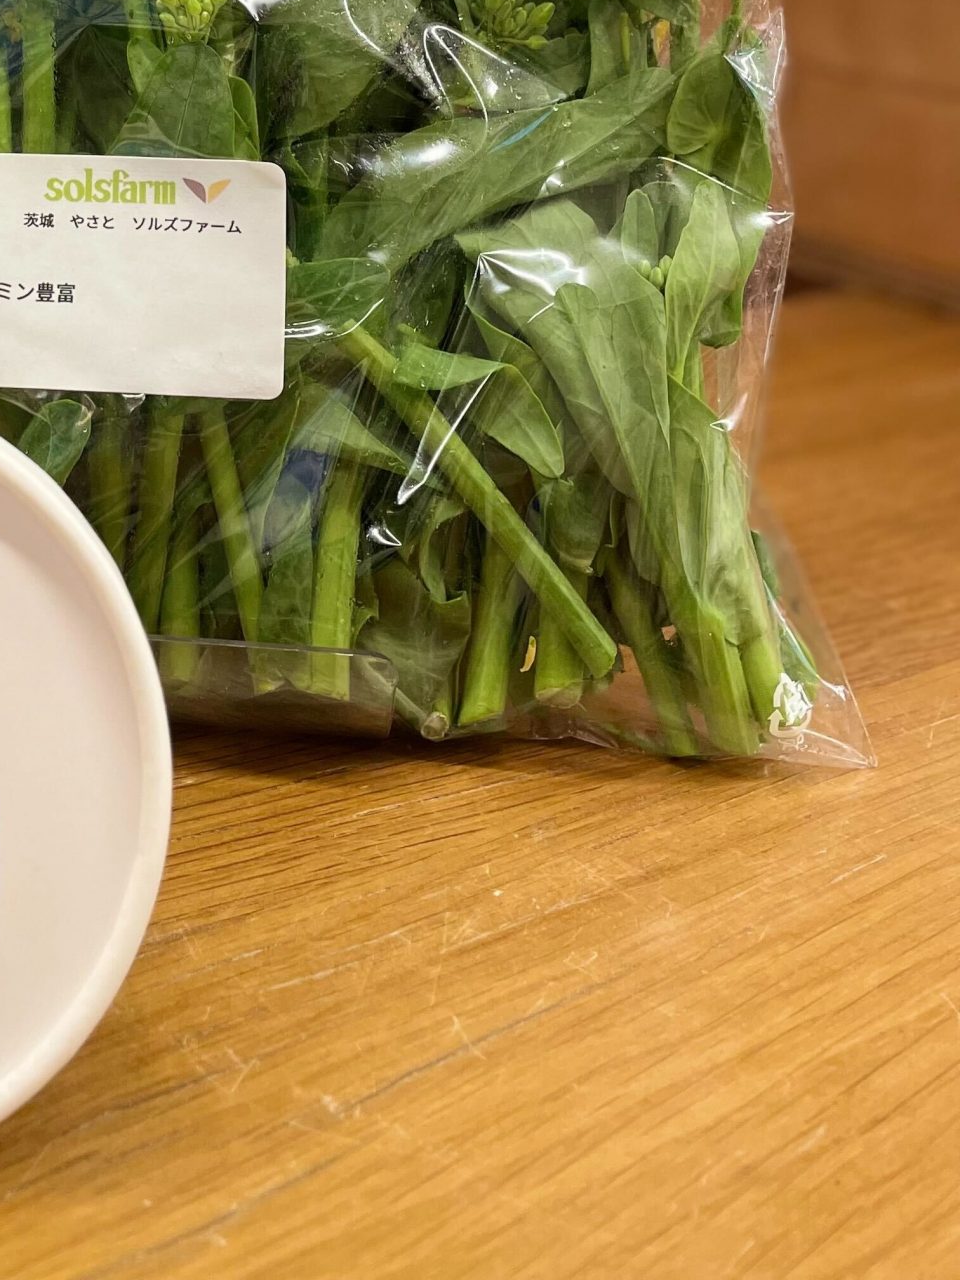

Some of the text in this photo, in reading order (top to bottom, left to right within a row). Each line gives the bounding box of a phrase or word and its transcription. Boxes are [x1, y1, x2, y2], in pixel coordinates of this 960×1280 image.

[44, 168, 175, 205] solsfarm
[23, 213, 242, 234] 茨城 やさと ソルズファーム
